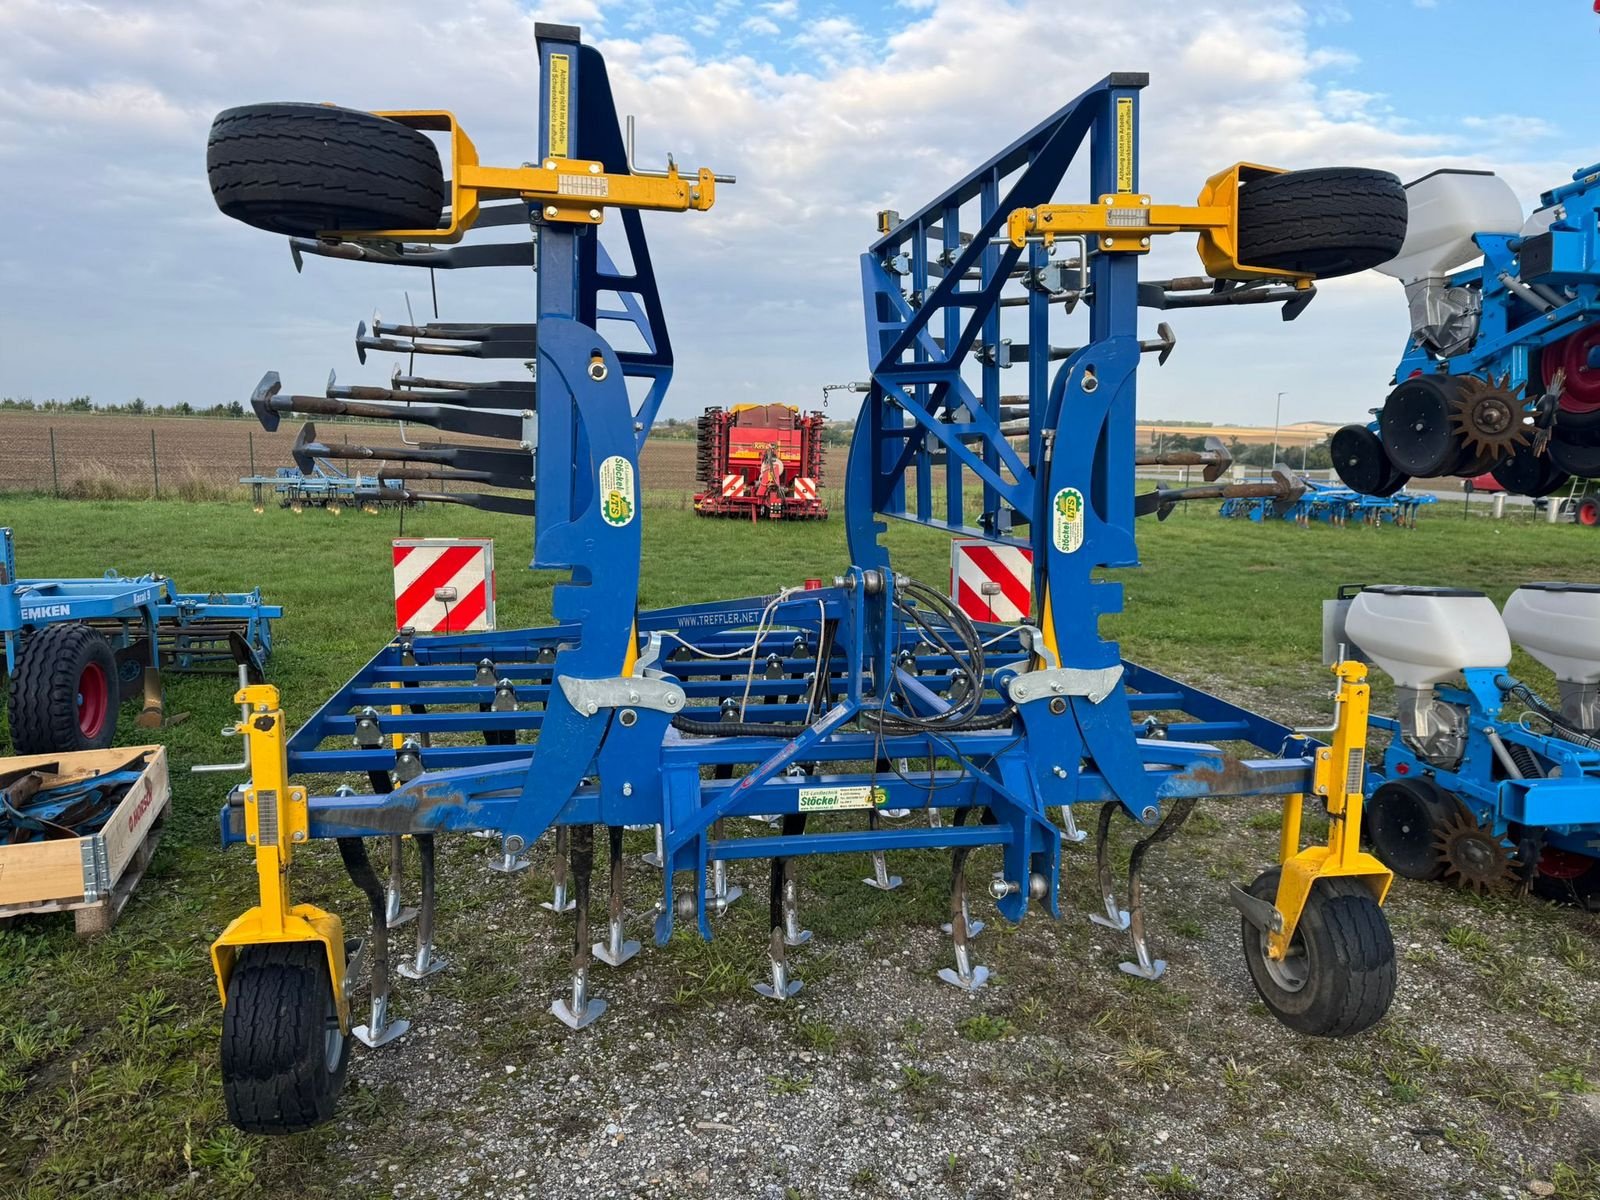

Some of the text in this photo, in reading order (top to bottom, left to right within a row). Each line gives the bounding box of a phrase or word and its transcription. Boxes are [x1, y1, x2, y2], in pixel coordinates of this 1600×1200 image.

[560, 111, 566, 119] im
[615, 458, 624, 490] Stöckel
[610, 494, 620, 515] LTS
[1067, 498, 1075, 518] LTS
[1061, 522, 1070, 551] Stöckel
[147, 589, 151, 600] 9
[677, 611, 759, 627] WWW.TREFFLER.NET
[800, 796, 837, 806] Stöckel
